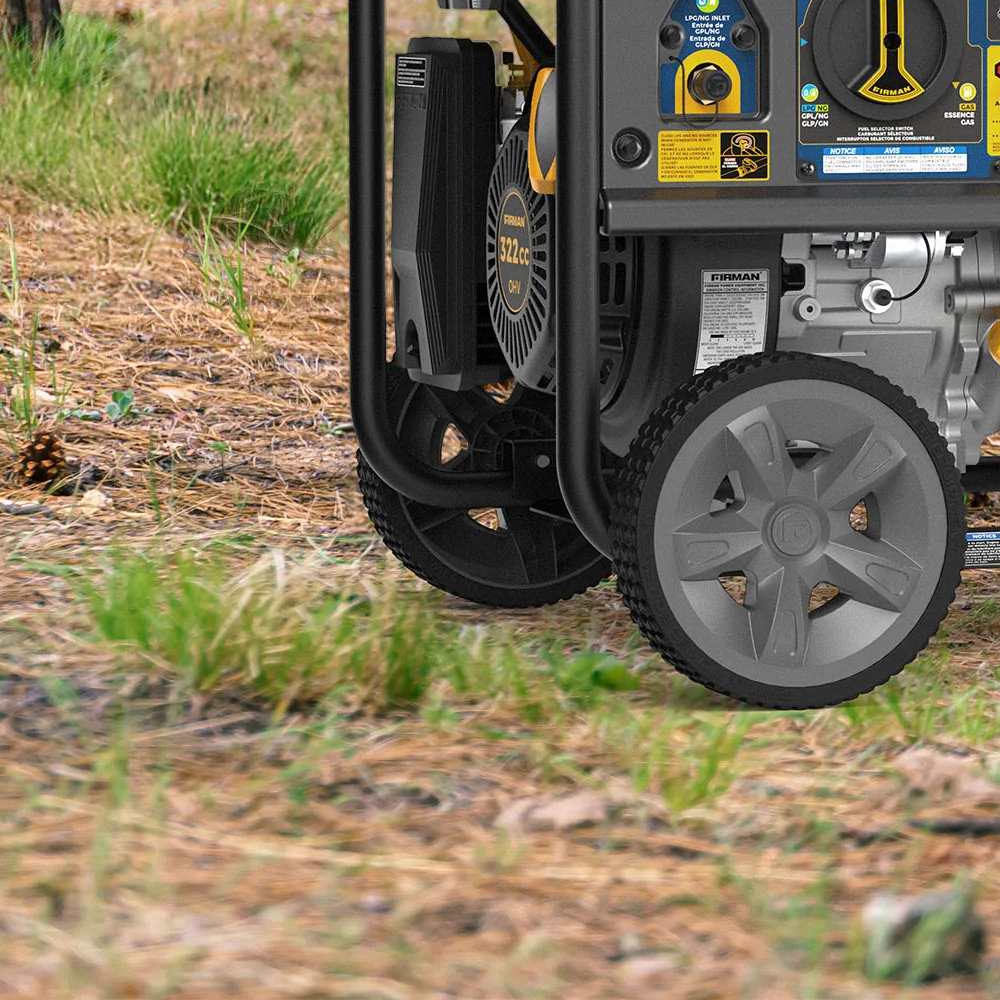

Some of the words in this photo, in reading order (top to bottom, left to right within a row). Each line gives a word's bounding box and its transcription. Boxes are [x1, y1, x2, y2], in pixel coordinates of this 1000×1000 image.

[872, 86, 911, 95] FIRMAN
[504, 214, 525, 227] FIRMAN
[711, 273, 760, 281] FIRMAN
[508, 279, 521, 294] OHV
